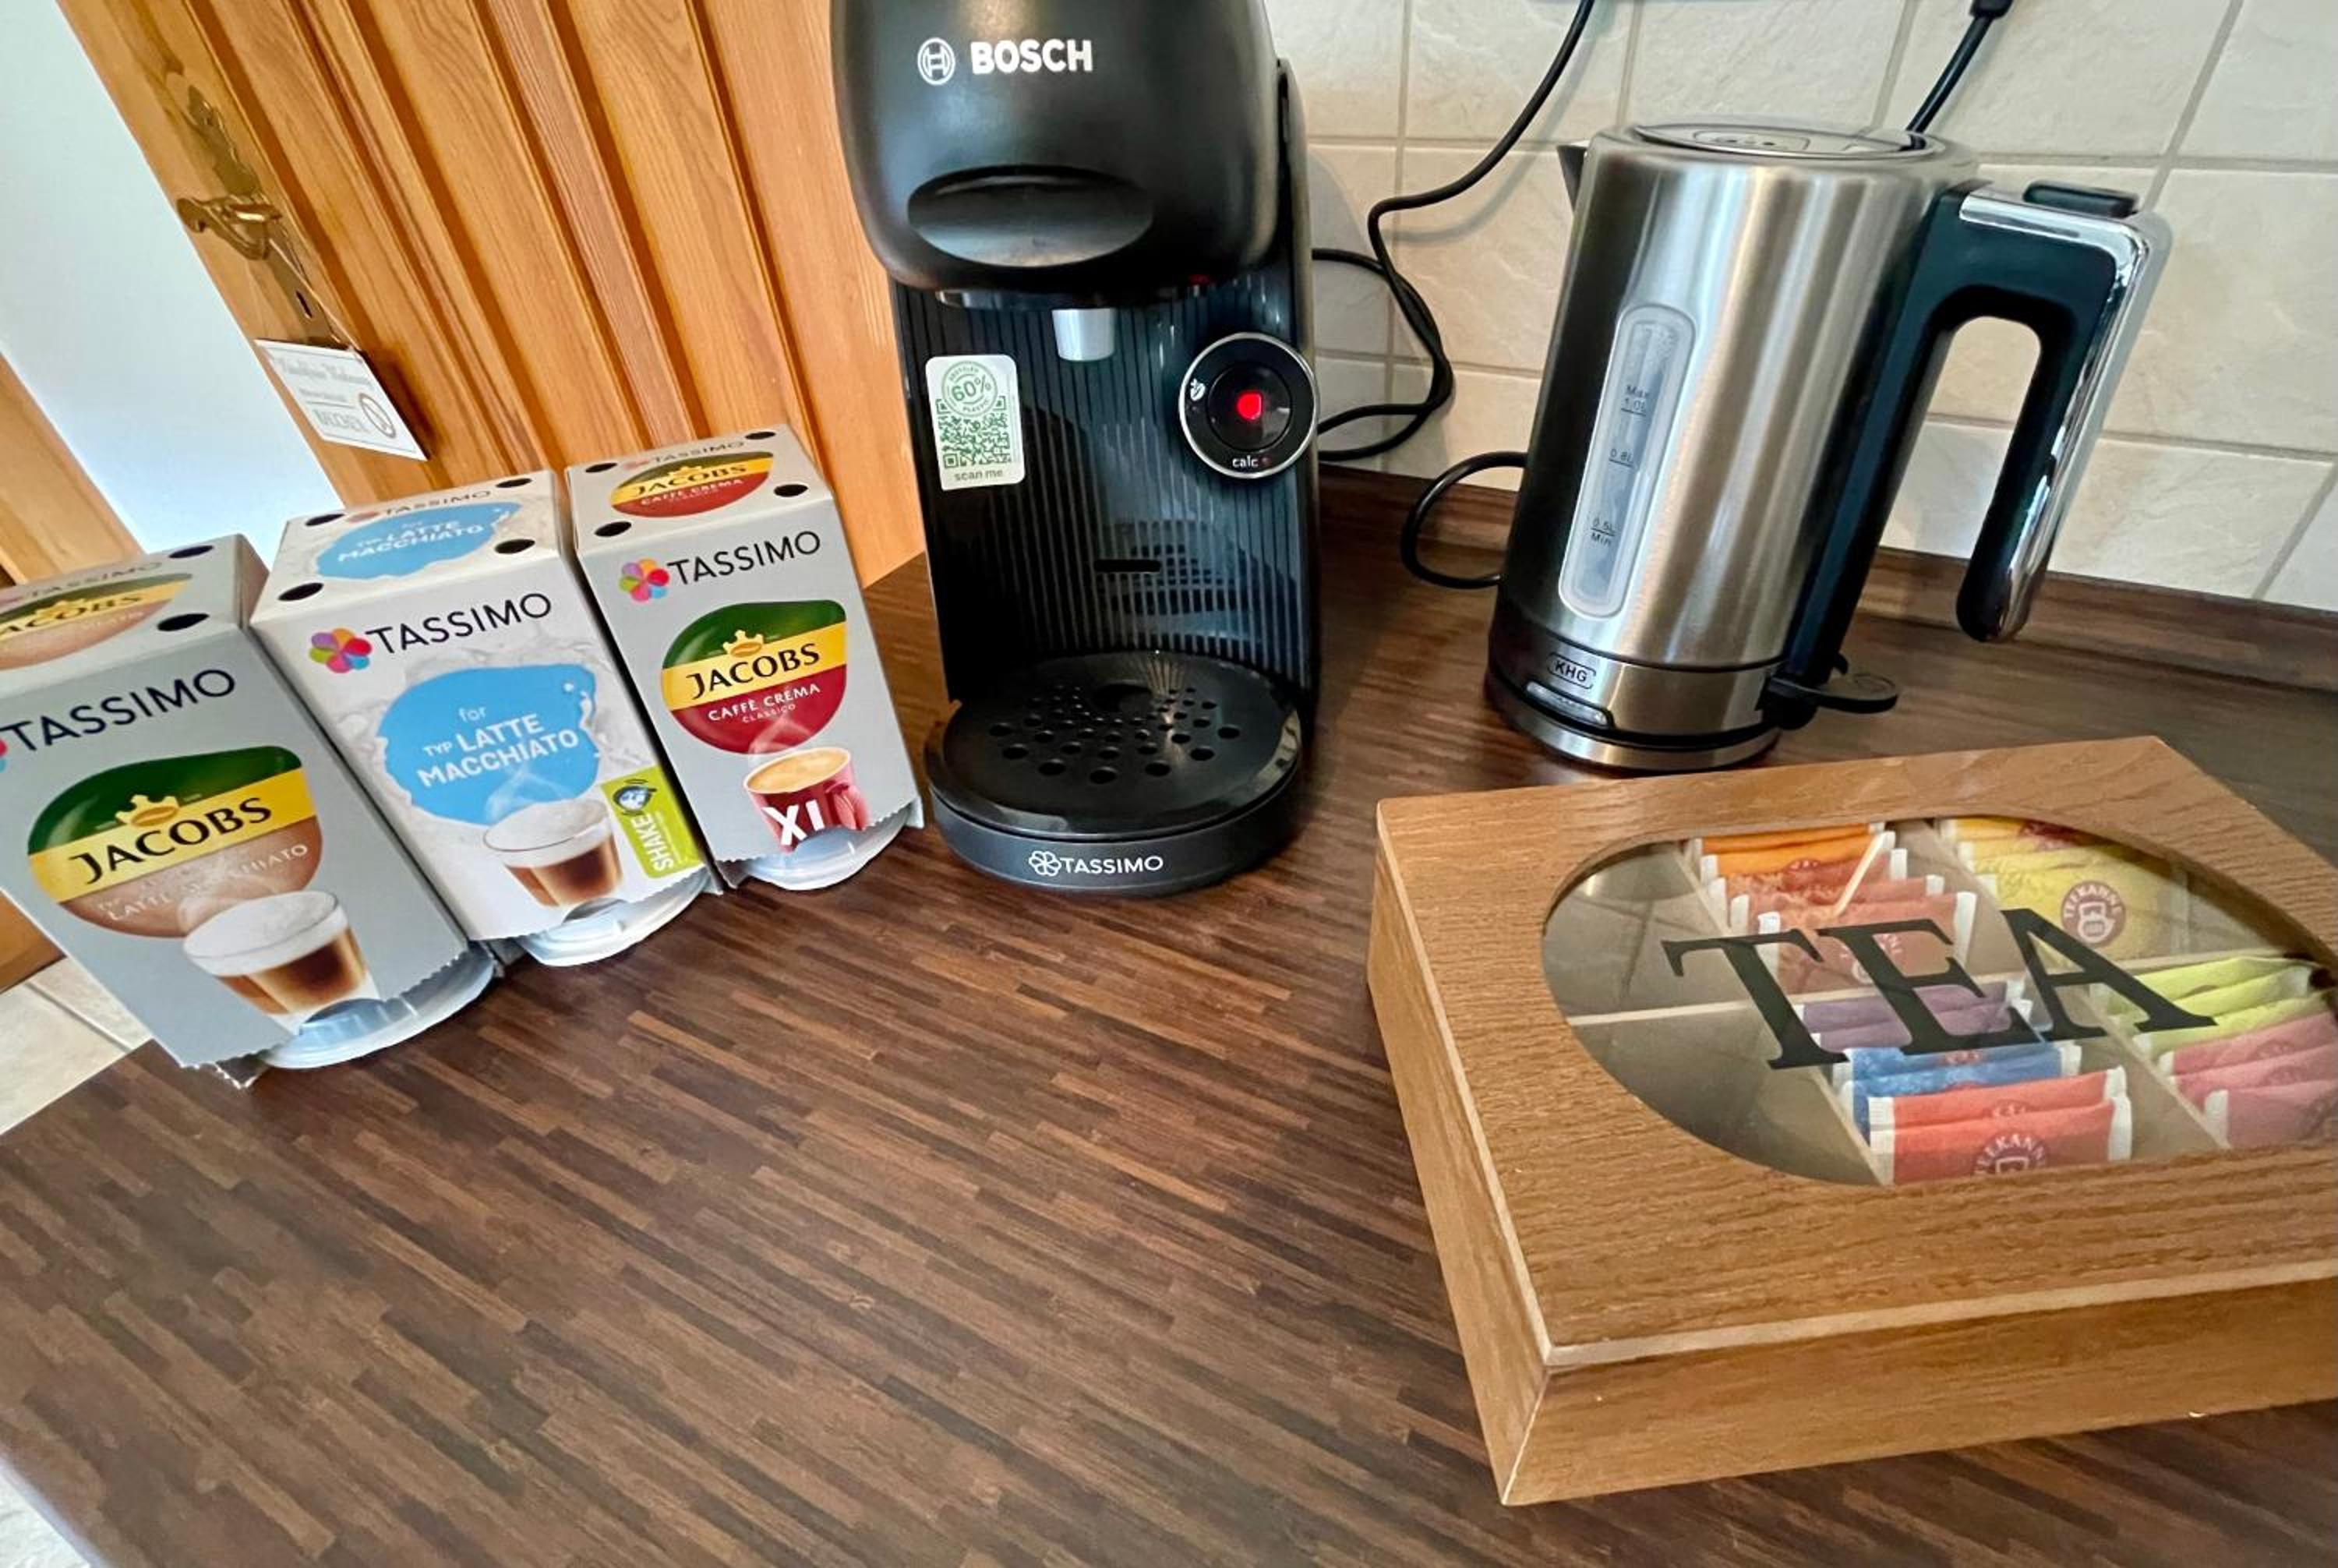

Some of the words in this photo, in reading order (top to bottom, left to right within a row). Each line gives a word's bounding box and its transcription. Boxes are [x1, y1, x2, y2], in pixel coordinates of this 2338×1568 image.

[970, 39, 1093, 75] BOSCH
[951, 374, 992, 402] 60%
[653, 440, 745, 463] TASSIMO
[1231, 455, 1259, 468] calc
[633, 464, 747, 496] JACOBS
[954, 471, 984, 482] scan
[984, 469, 1004, 479] me
[383, 490, 491, 515] TASSIMO
[337, 524, 485, 563] MACCHIATO
[386, 520, 461, 542] LATTE
[1590, 531, 1612, 547] Min
[667, 530, 821, 585] TASSIMO
[0, 595, 143, 636] ACOBS
[365, 592, 553, 655] TASSIMO
[686, 643, 821, 700] JACOBS
[1555, 659, 1588, 683] KHG
[2, 668, 236, 754] TASSIMO
[763, 683, 821, 707] CREMA
[458, 707, 487, 722] for
[741, 704, 796, 724] CLASSICO
[422, 741, 454, 758] TYP
[455, 712, 545, 753] LATTE
[416, 729, 580, 788] MACCHIATO
[70, 797, 272, 885] JACOBS
[630, 812, 675, 872] SHAKE
[1060, 855, 1164, 875] TASSIMO
[1661, 907, 2219, 1070] TEA
